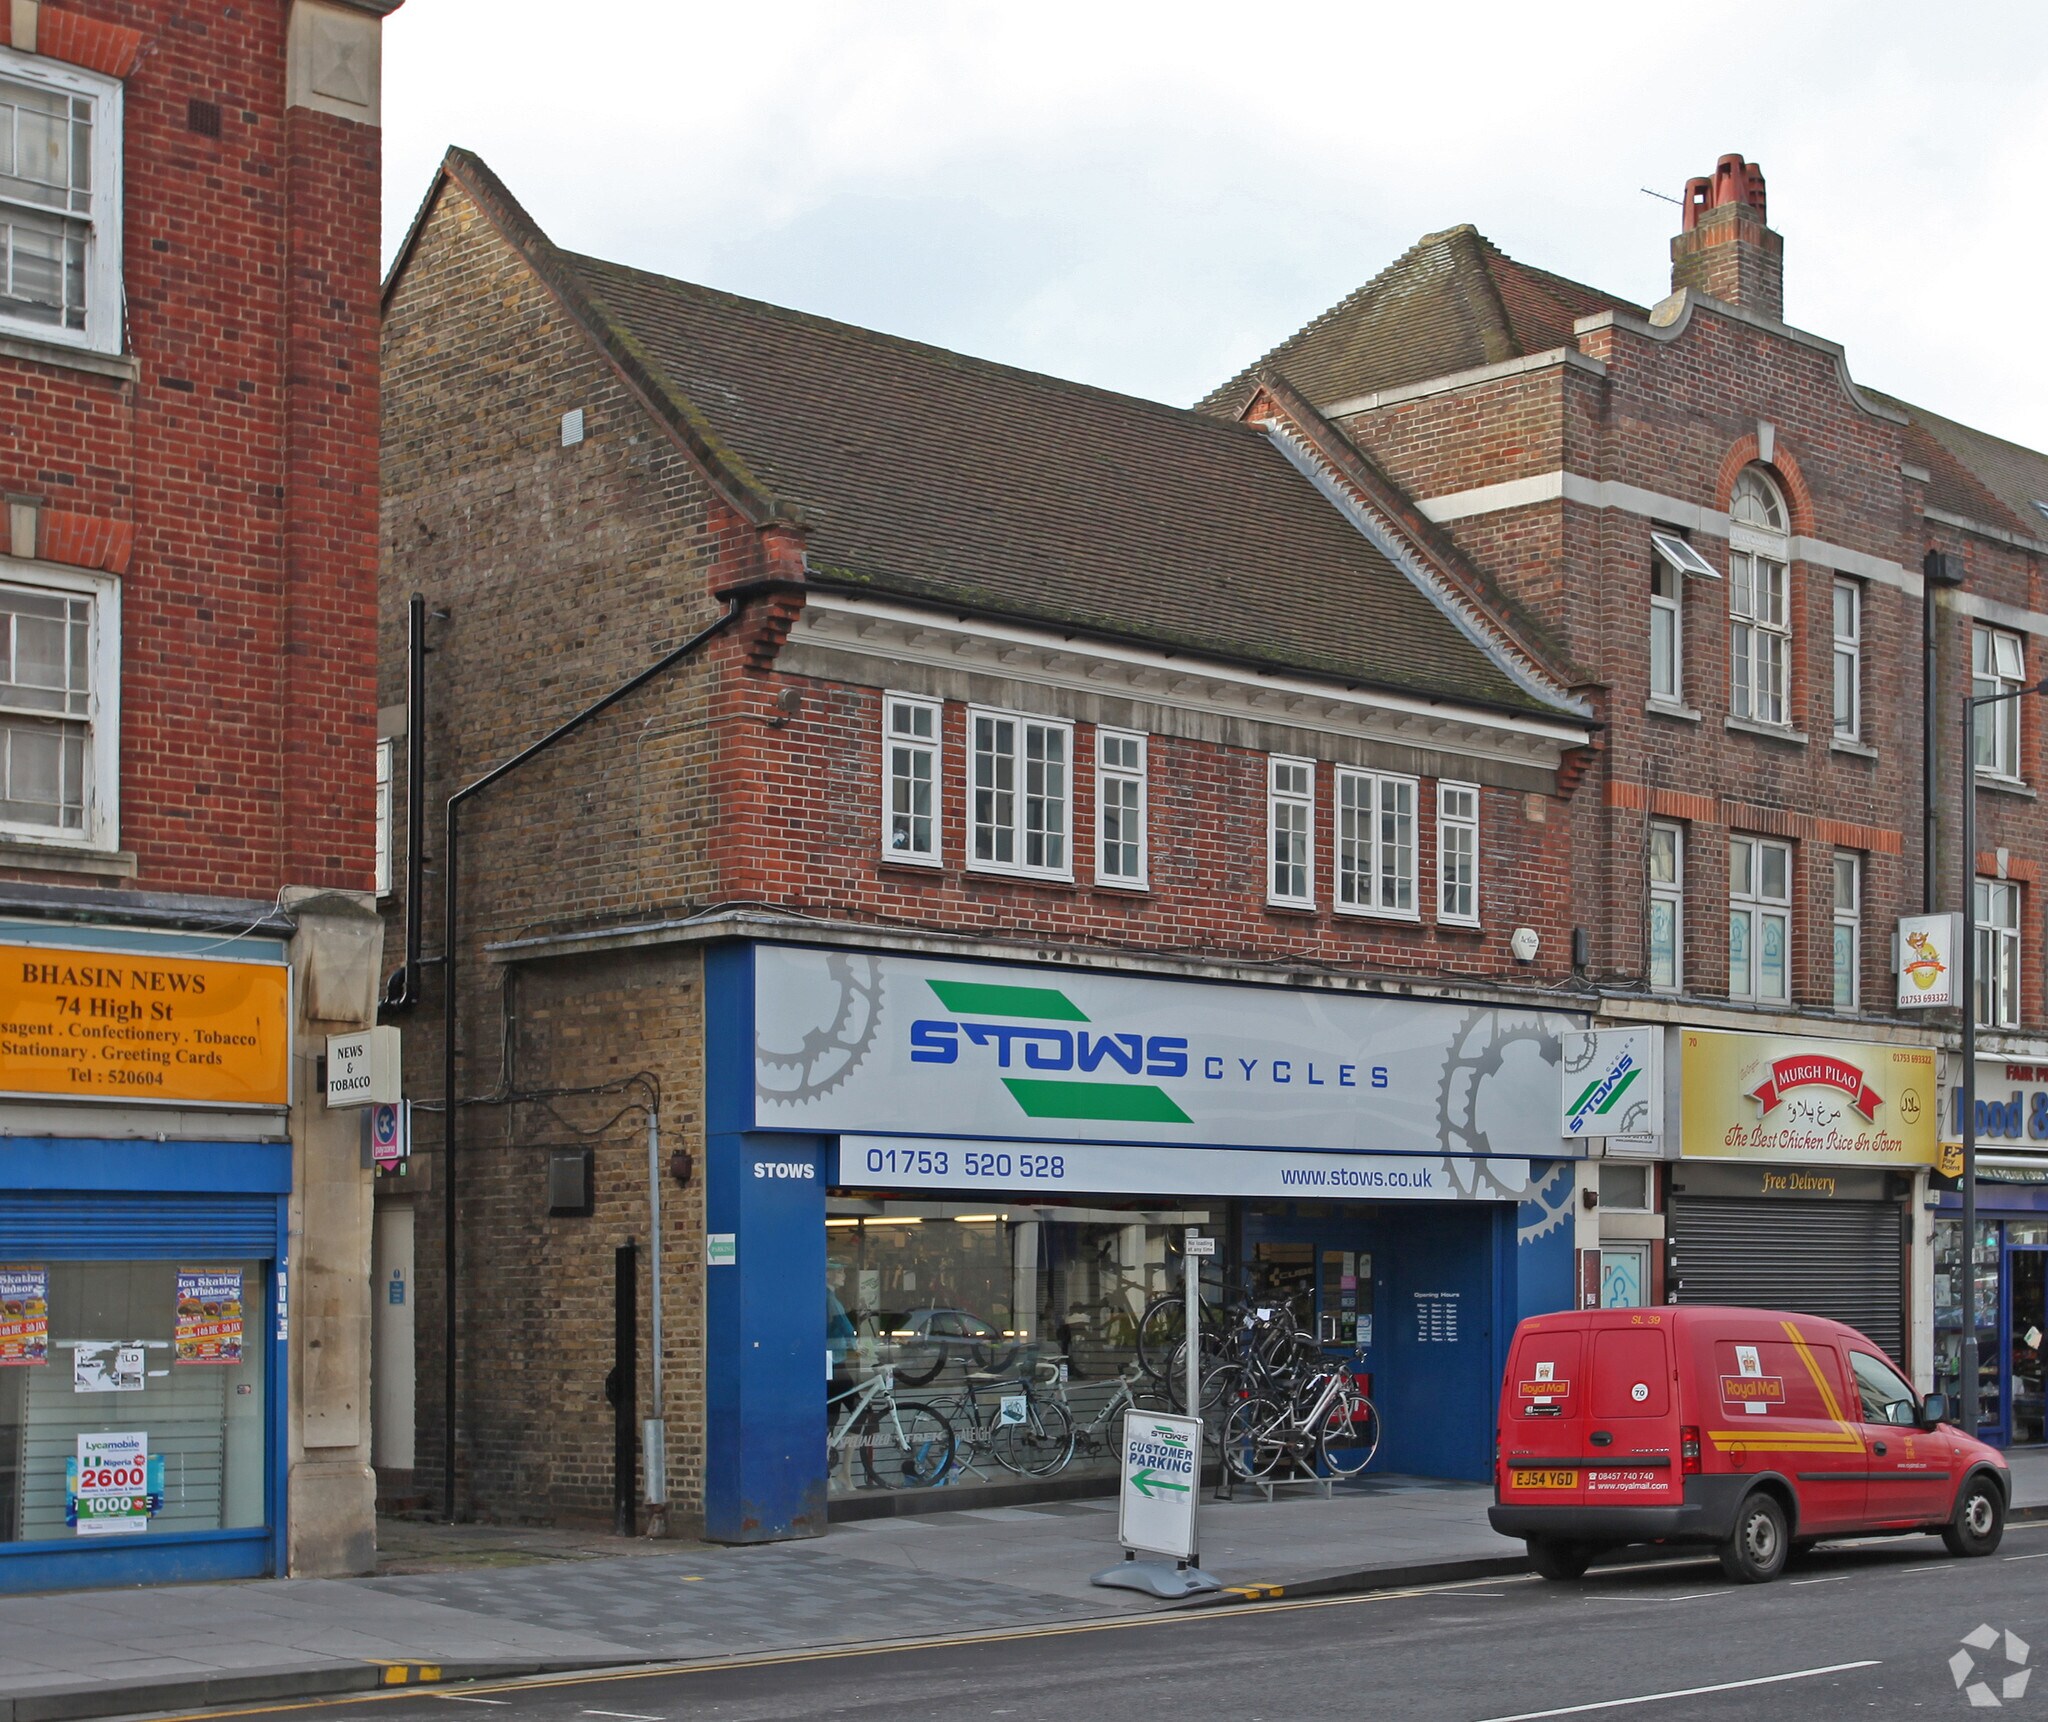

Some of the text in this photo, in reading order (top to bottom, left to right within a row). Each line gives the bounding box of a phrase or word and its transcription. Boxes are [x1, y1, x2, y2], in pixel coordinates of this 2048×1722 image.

[22, 964, 206, 994] BHASIN NEWS
[1900, 993, 1948, 1005] 01753 693322
[56, 995, 174, 1024] 74 High St
[68, 1023, 180, 1045] Confectionery
[193, 1029, 257, 1046] Tobacco
[1689, 1037, 1698, 1048] 70
[1, 1041, 222, 1066] Stationary Greeting Cards
[337, 1045, 363, 1060] NEWS
[910, 1019, 1389, 1089] STOWS CYCLES
[1892, 1053, 1932, 1065] 01753 693322
[346, 1062, 354, 1074] &
[2006, 1065, 2034, 1082] FAIR
[68, 1067, 163, 1086] Tel 520604
[330, 1075, 371, 1092] TOBACCO
[1779, 1065, 1821, 1086] MURGH
[1825, 1065, 1857, 1089] PILAO
[1569, 1053, 1634, 1134] STOWS
[1724, 1124, 1748, 1148] The
[1750, 1124, 1778, 1149] Best
[1778, 1129, 1824, 1150] Chicken
[1827, 1128, 1853, 1151] Rice
[1871, 1130, 1903, 1152] Town
[866, 1149, 1065, 1179] 01753 520 528
[1941, 1163, 1961, 1172] Point
[1942, 1157, 1956, 1166] Pay
[753, 1162, 815, 1180] STOWS
[1281, 1168, 1433, 1189] www.stows.co.uk
[1761, 1171, 1836, 1197] Free Delivery
[178, 1276, 240, 1288] Ice Skating
[191, 1287, 230, 1297] Windsor
[1631, 1315, 1661, 1325] SL 39
[1522, 1383, 1566, 1394] Royal Mail
[1634, 1389, 1645, 1397] 70
[1726, 1379, 1780, 1398] Royal Mail
[1151, 1430, 1189, 1442] STOWS
[85, 1440, 140, 1451] Lycamobile
[1129, 1441, 1193, 1461] CUSTOMER
[103, 1458, 132, 1467] Nigeria
[1129, 1453, 1192, 1474] PARKING
[81, 1468, 144, 1488] 2600
[1516, 1472, 1573, 1486] EJ54 YGD
[1598, 1472, 1654, 1480] 08457 740 740
[1598, 1482, 1668, 1492] www.royalmail.com
[86, 1497, 132, 1513] 1000
